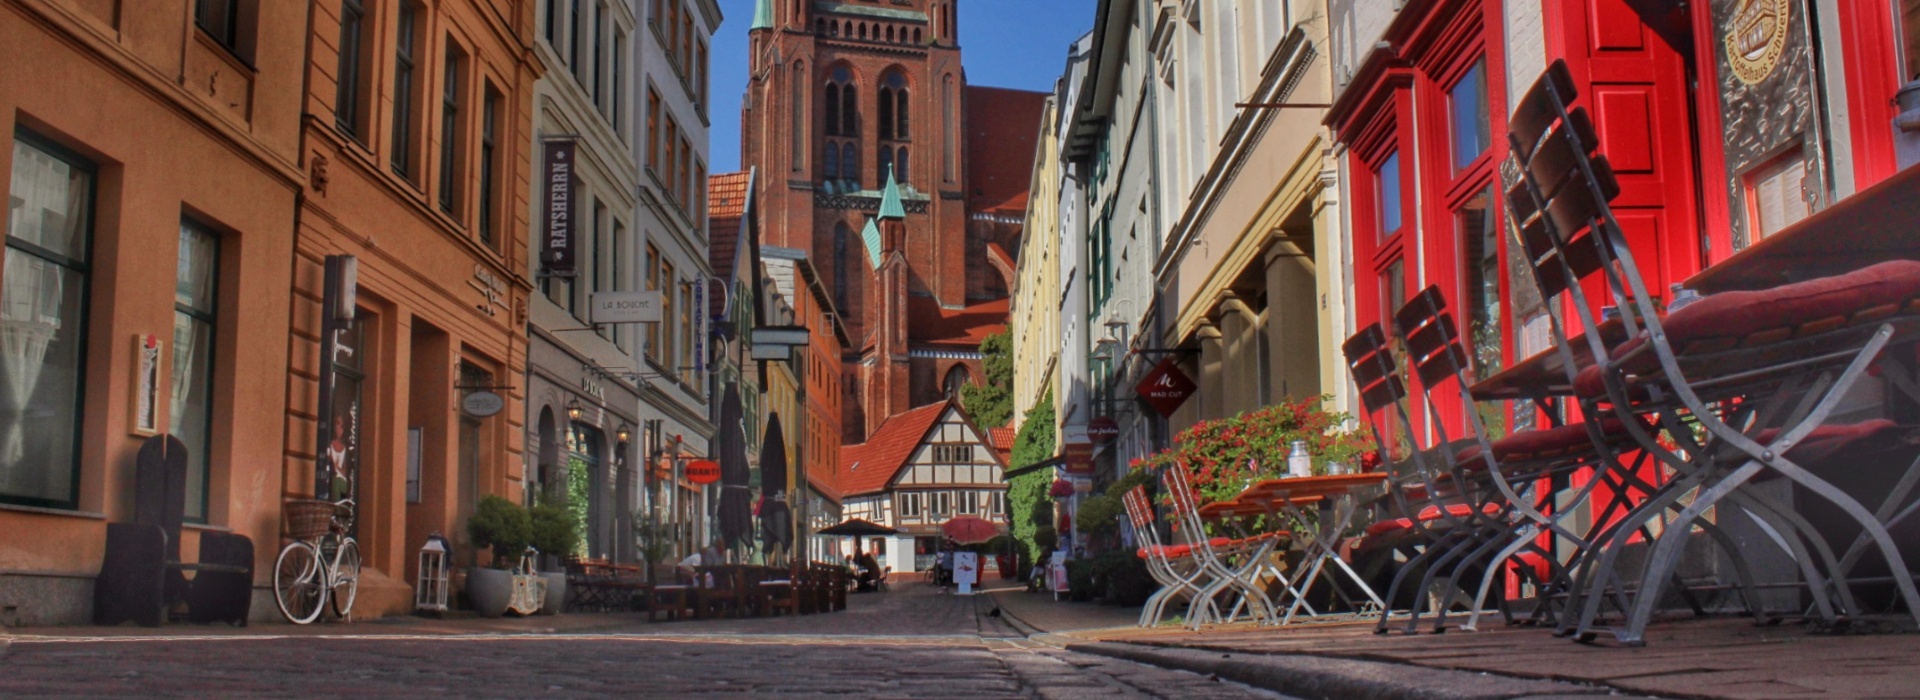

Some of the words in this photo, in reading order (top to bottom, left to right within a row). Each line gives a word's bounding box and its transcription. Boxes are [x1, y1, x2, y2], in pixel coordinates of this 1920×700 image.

[1726, 34, 1768, 81] Kartoffelhaus
[551, 163, 568, 248] RATSHERRN
[602, 301, 613, 310] LA
[617, 300, 650, 310] BOUCHE
